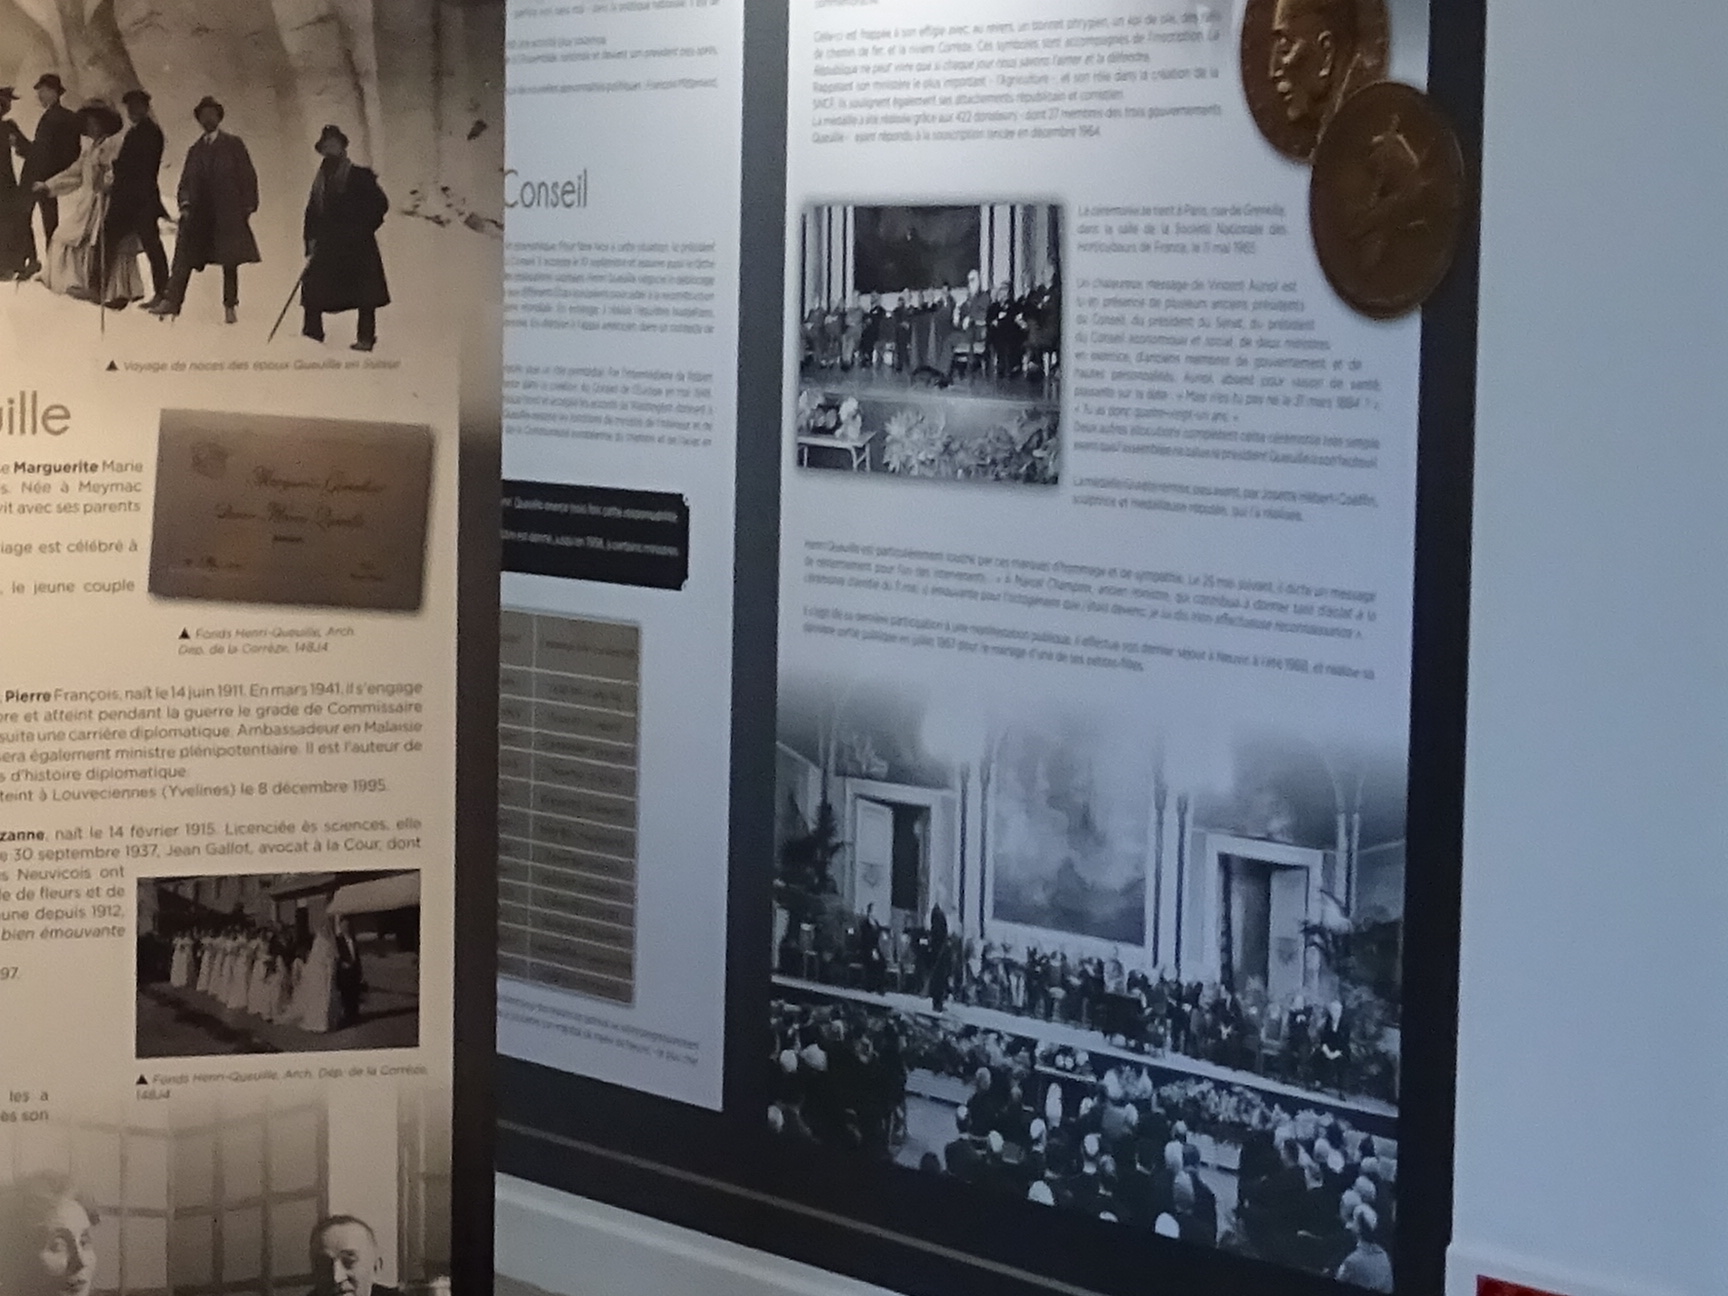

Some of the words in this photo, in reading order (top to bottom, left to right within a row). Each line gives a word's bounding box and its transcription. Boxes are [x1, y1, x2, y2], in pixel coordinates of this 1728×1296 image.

[13, 459, 100, 477] Marguerite
[101, 459, 144, 473] Marie
[20, 480, 52, 495] Née
[59, 480, 70, 495] à
[16, 502, 53, 516] avec
[55, 502, 80, 514] ses
[82, 499, 141, 516] parents
